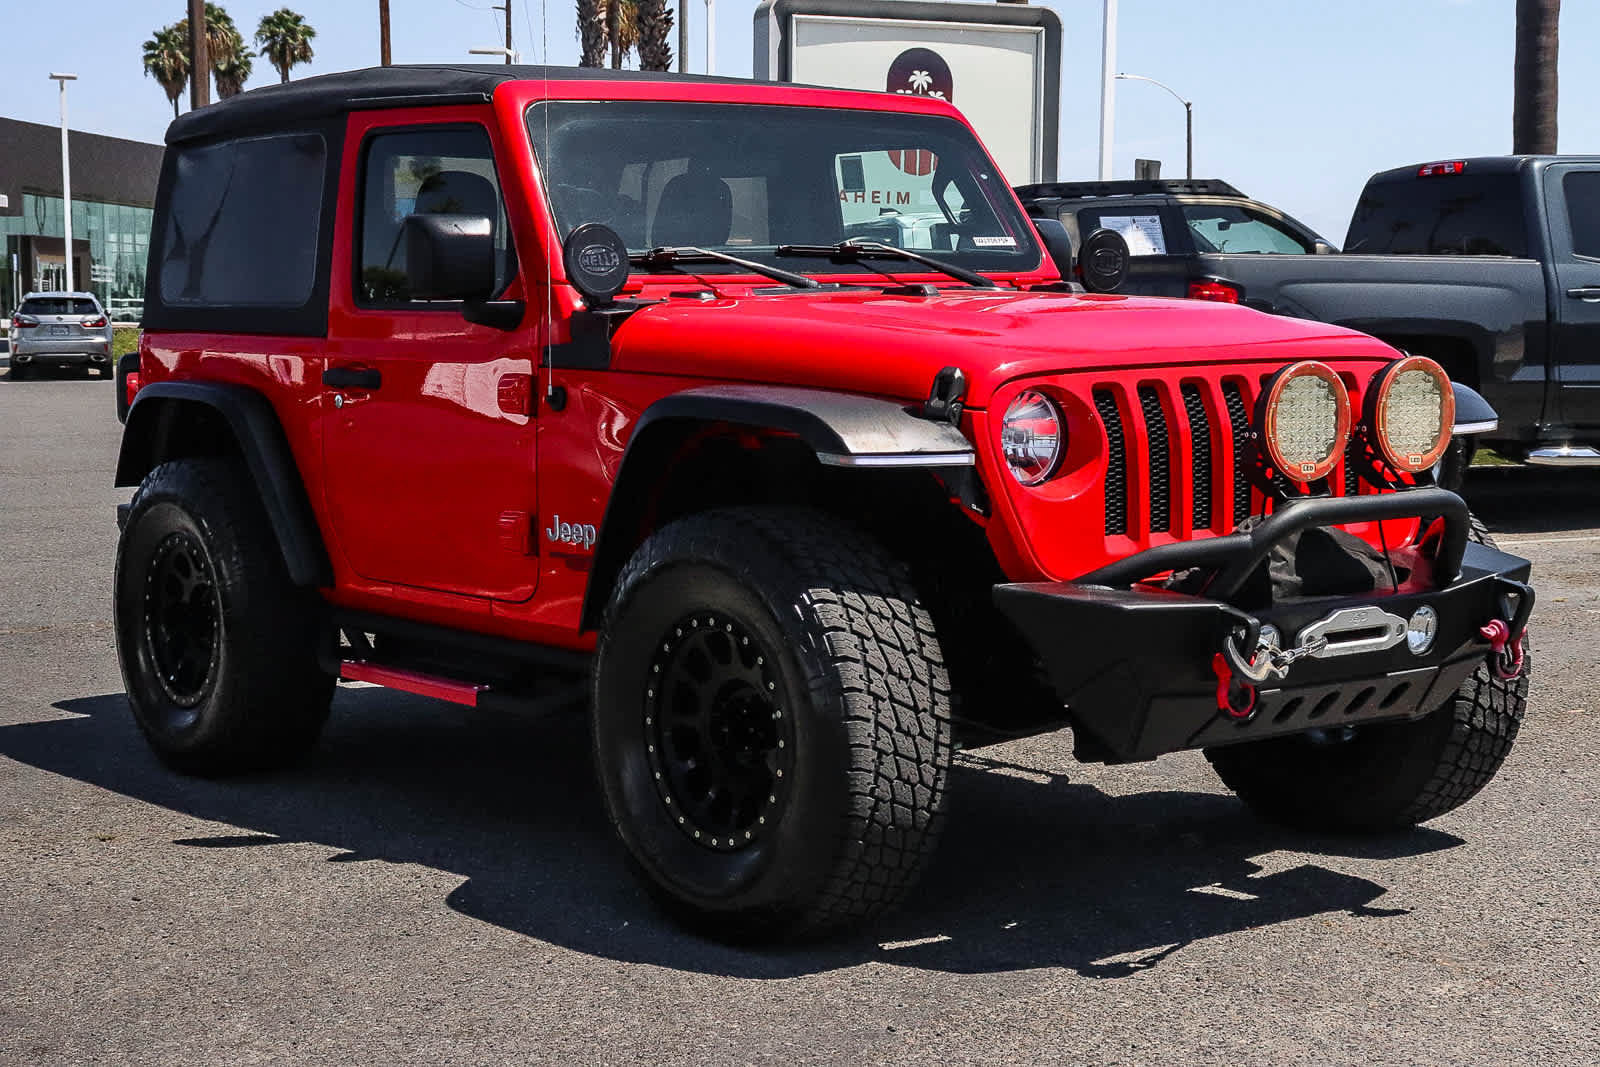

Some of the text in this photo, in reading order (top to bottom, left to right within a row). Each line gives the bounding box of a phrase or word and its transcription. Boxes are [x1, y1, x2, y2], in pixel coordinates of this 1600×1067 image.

[581, 252, 620, 266] HELLA
[1302, 464, 1314, 472] LED
[545, 514, 596, 551] Jeep
